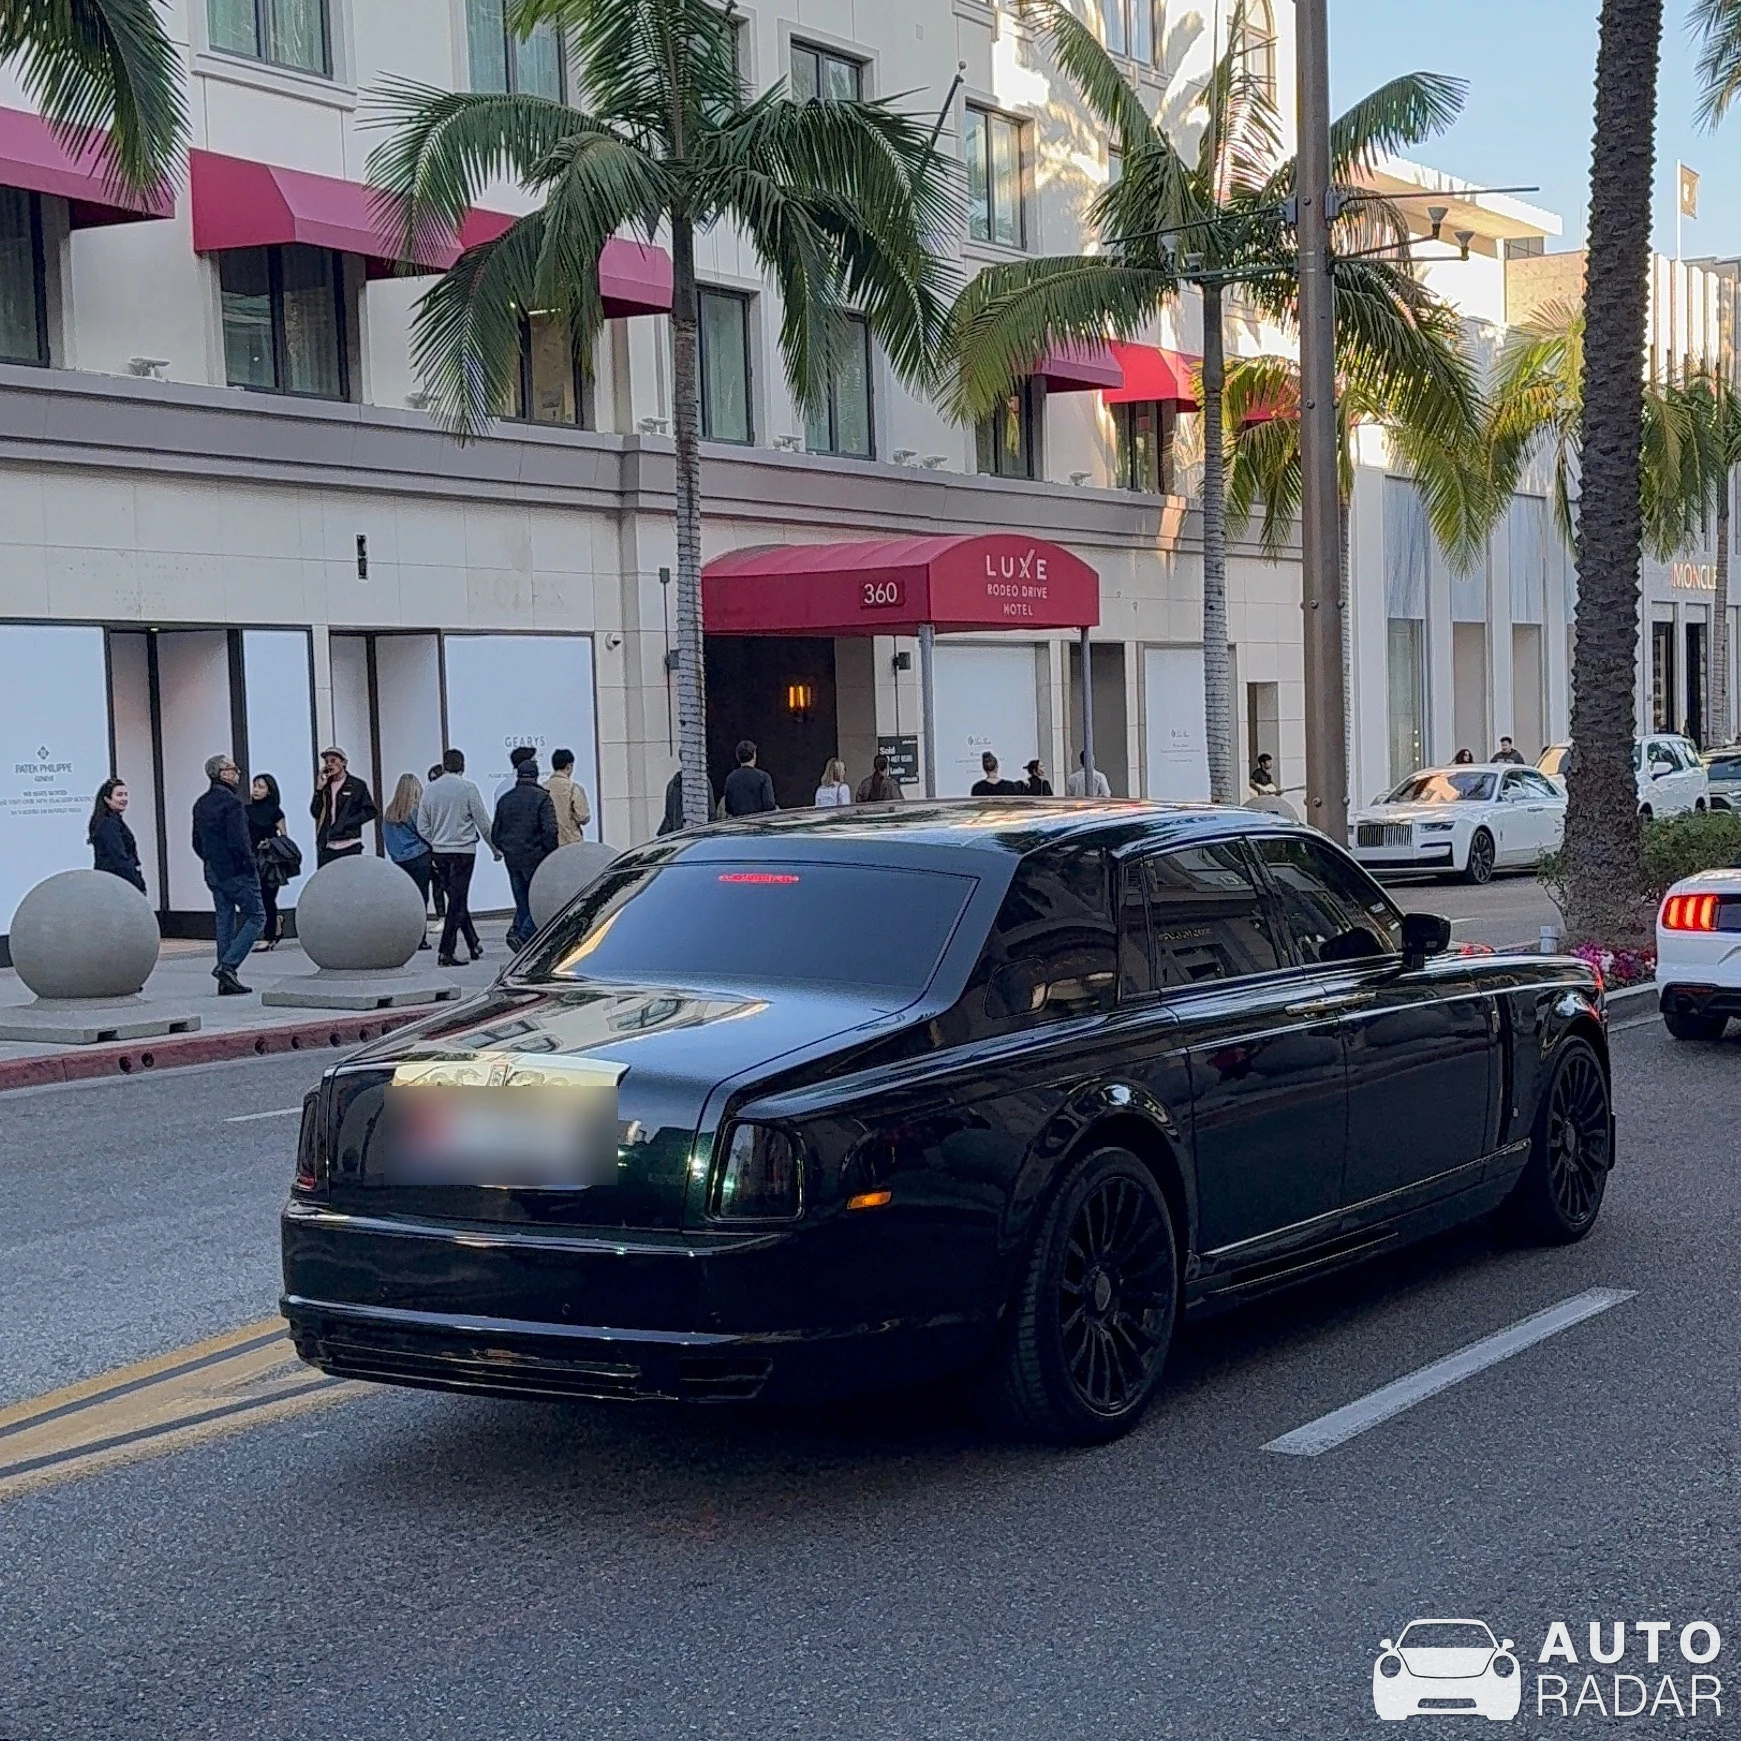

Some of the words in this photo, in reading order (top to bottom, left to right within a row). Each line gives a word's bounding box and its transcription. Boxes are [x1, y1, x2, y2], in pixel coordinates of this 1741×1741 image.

[985, 549, 1048, 580] LUXE
[863, 582, 898, 605] 360
[987, 583, 1019, 597] RODEO
[1021, 585, 1048, 599] DRIVE
[1003, 603, 1034, 617] HOTEL
[504, 735, 546, 748] GEARYS
[15, 763, 39, 774] PATEK
[39, 762, 73, 773] PHILIPPE
